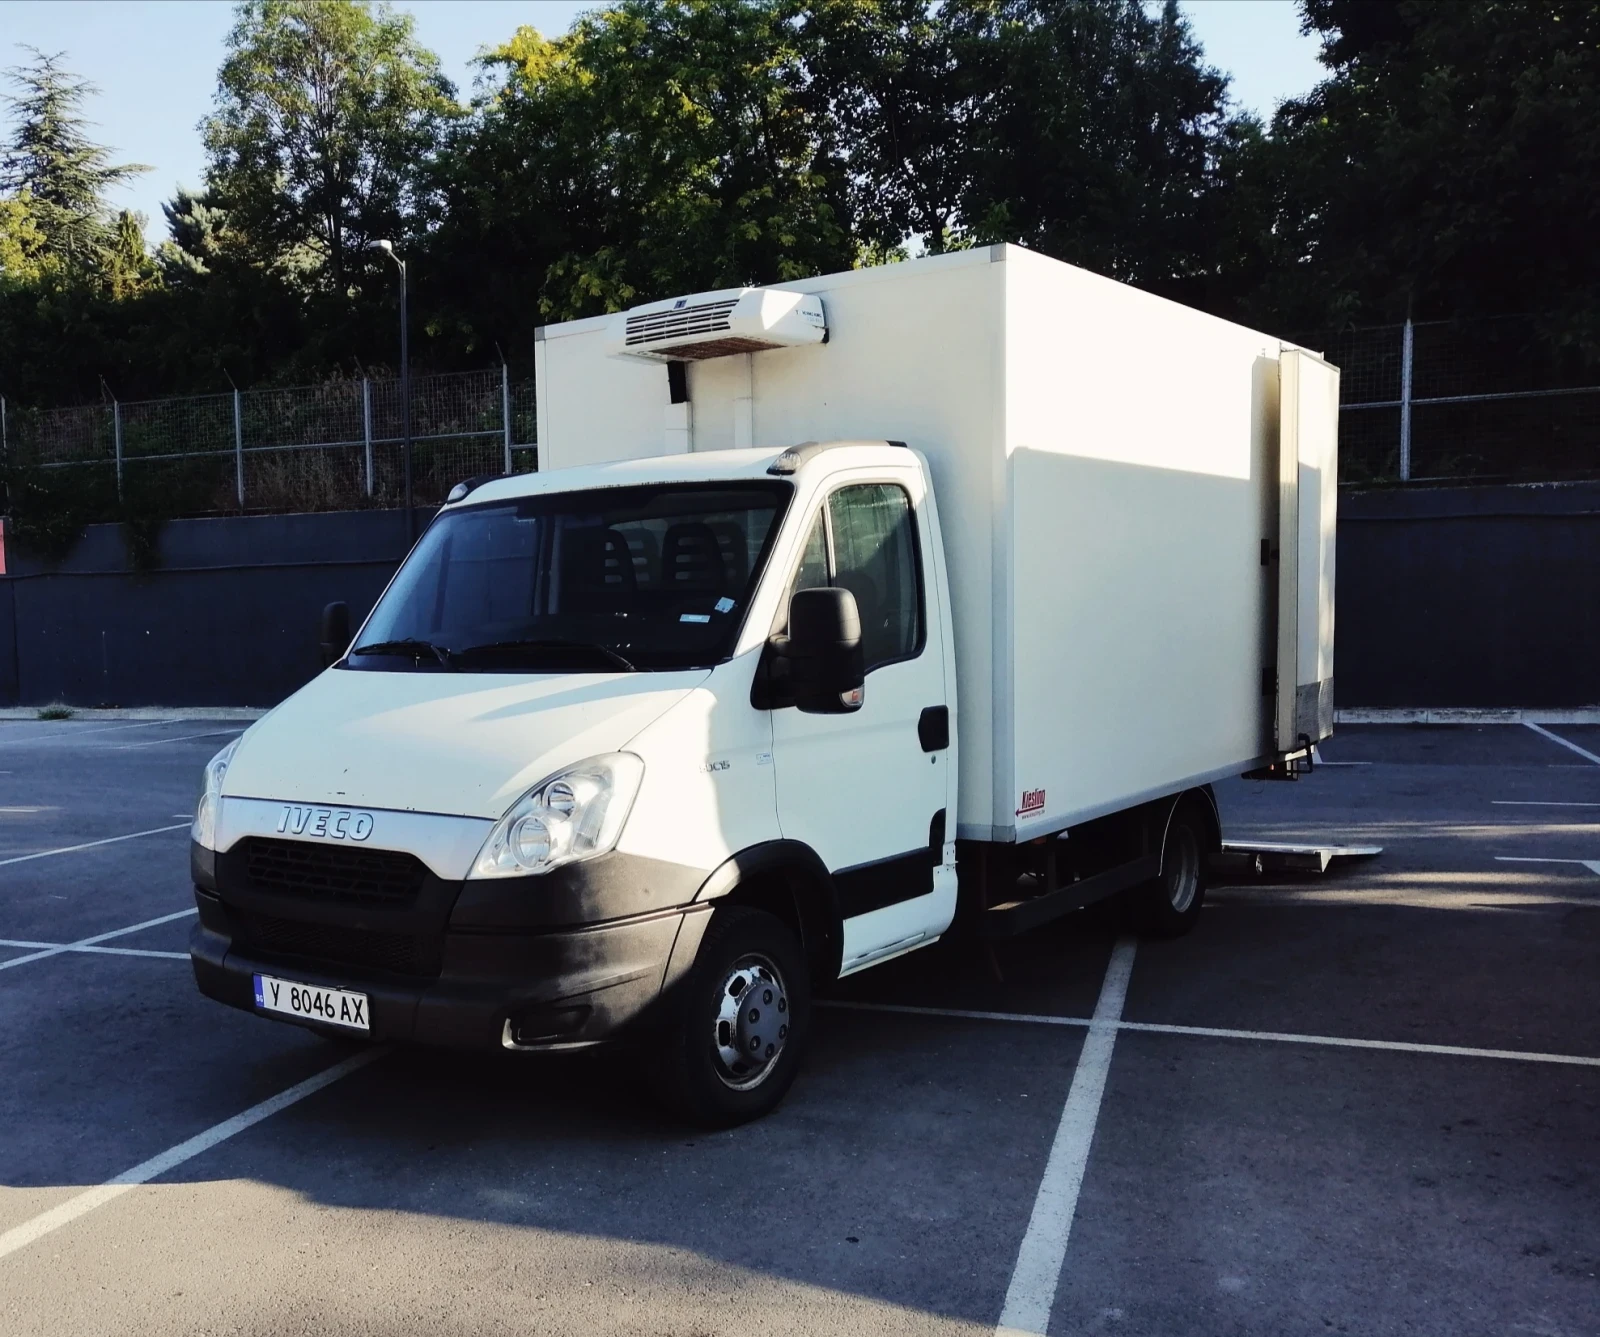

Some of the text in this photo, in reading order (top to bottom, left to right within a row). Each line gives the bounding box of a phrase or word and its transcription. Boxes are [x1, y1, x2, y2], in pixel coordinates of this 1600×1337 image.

[277, 806, 374, 841] IVECO
[270, 982, 365, 1025] Y 8046 AX
